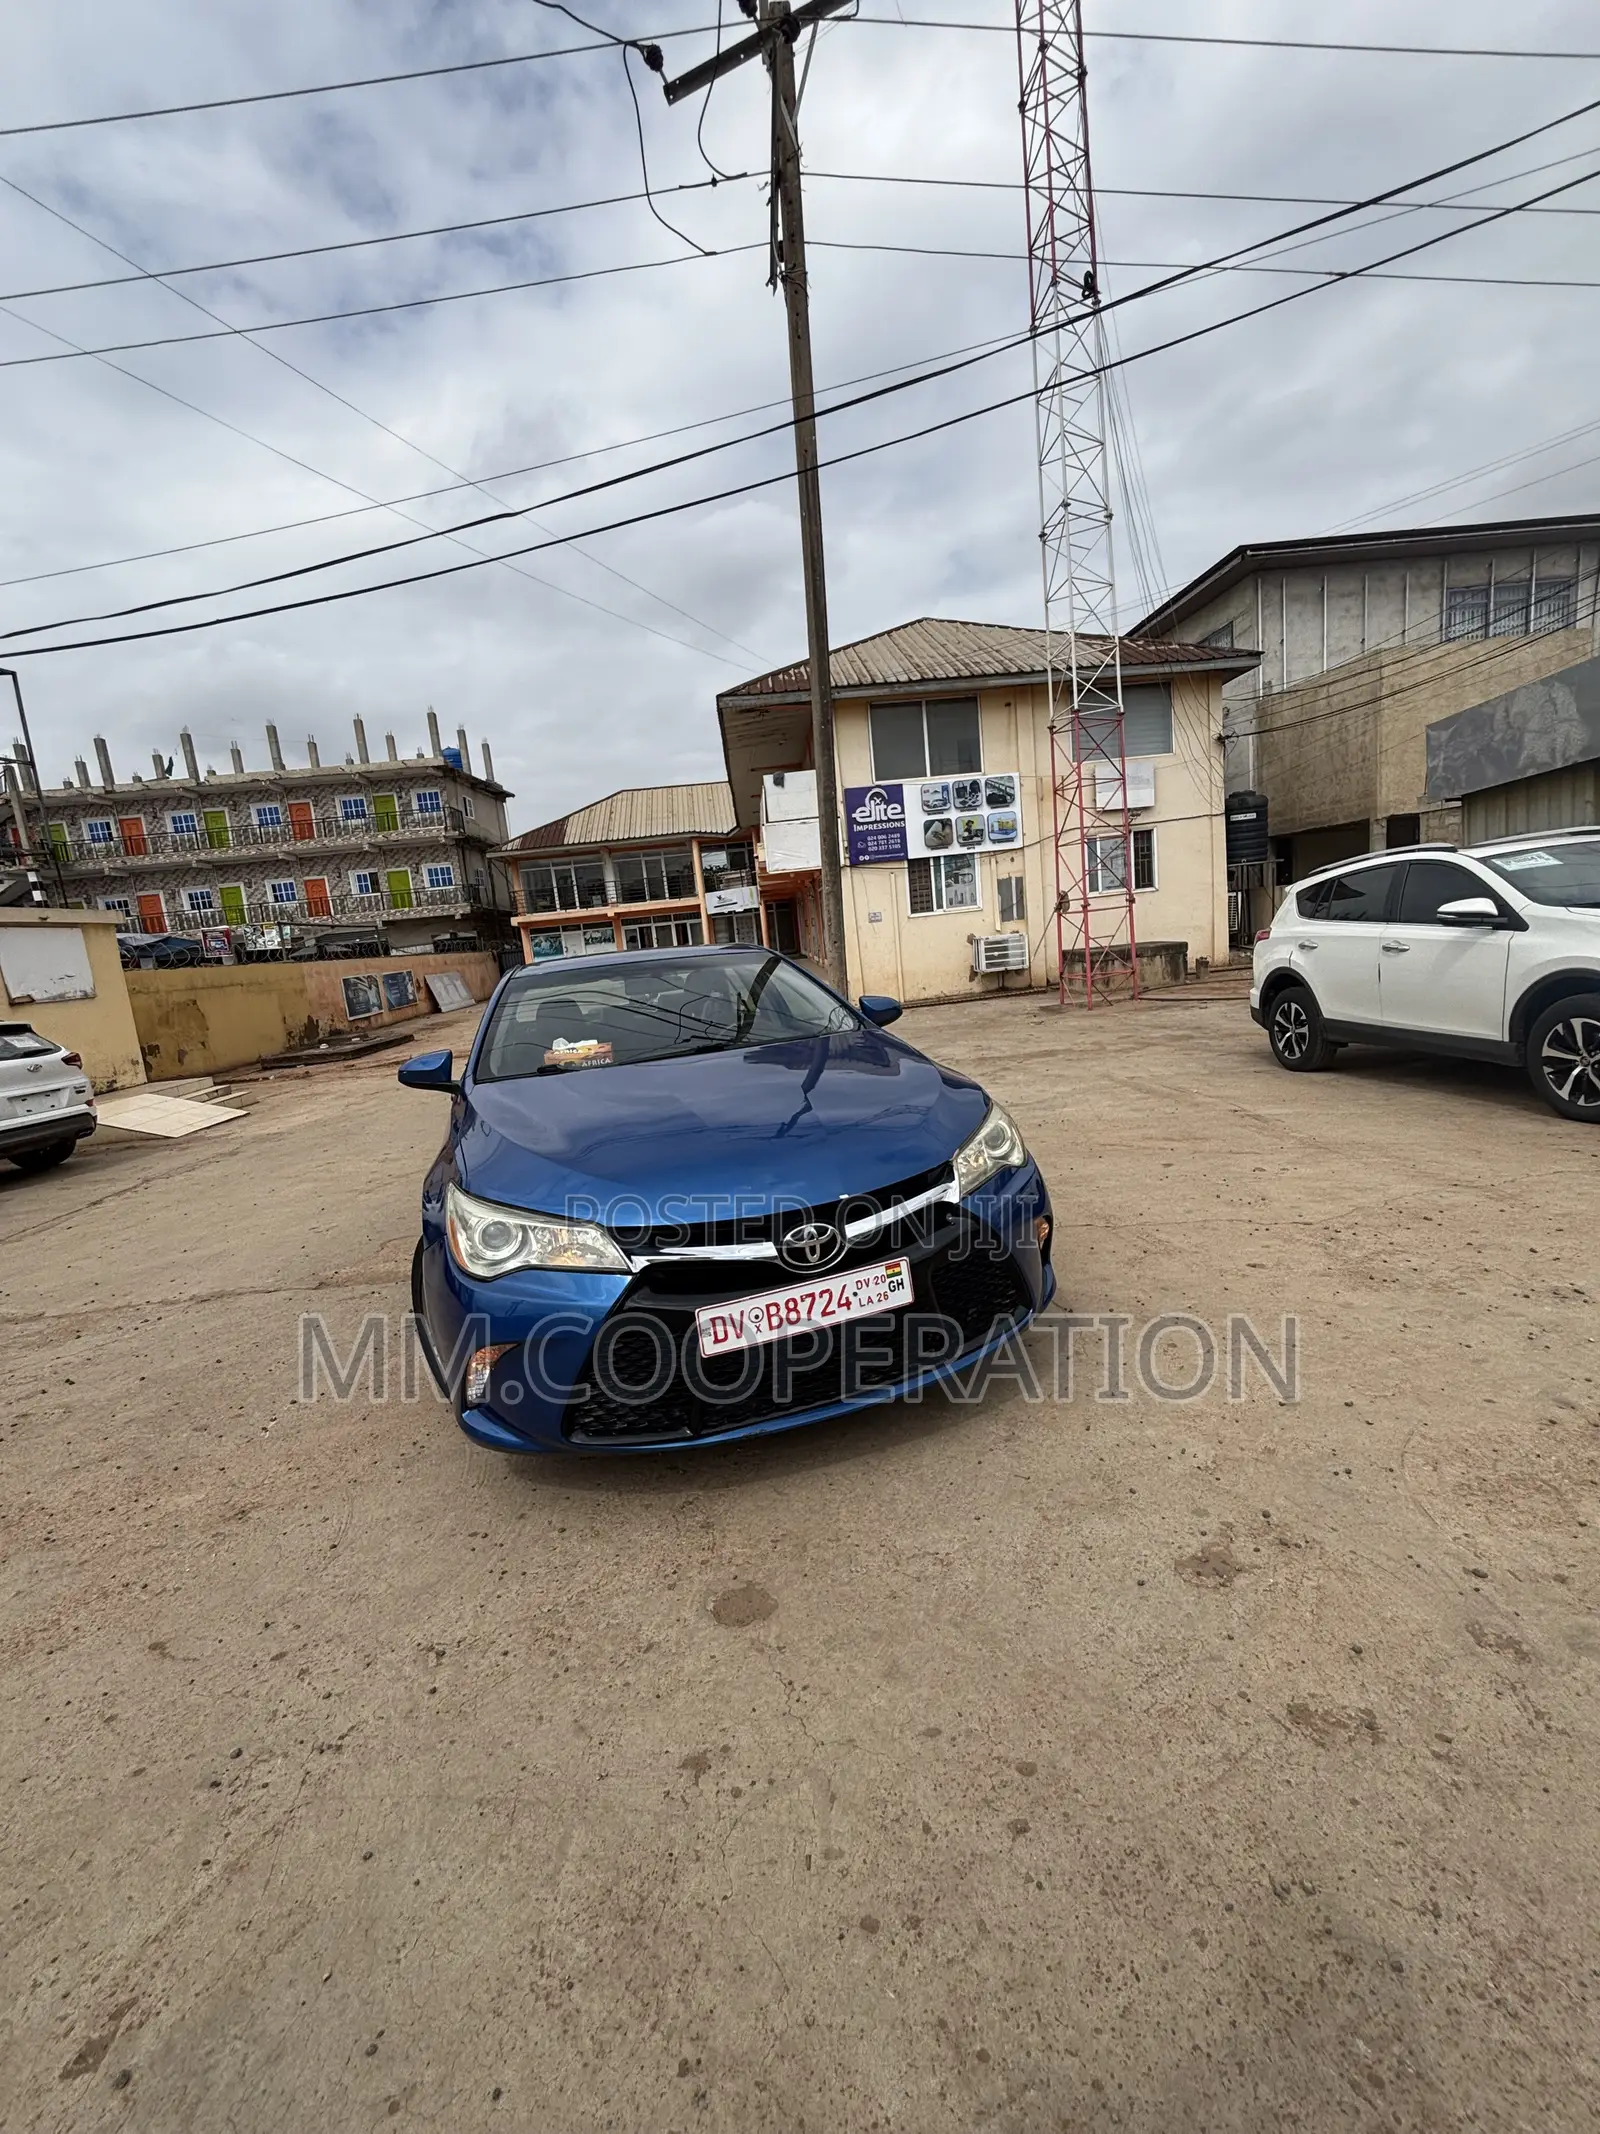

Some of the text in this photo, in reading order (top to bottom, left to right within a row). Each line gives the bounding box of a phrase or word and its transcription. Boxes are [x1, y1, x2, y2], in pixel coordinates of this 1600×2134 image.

[853, 820, 906, 833] IMPRESSIONS
[581, 1058, 612, 1067] AFRICA
[855, 1274, 886, 1290] DV 20
[888, 1277, 905, 1293] GH
[858, 1290, 889, 1308] LA 26
[709, 1309, 745, 1345] DV
[765, 1284, 852, 1332] B8724
